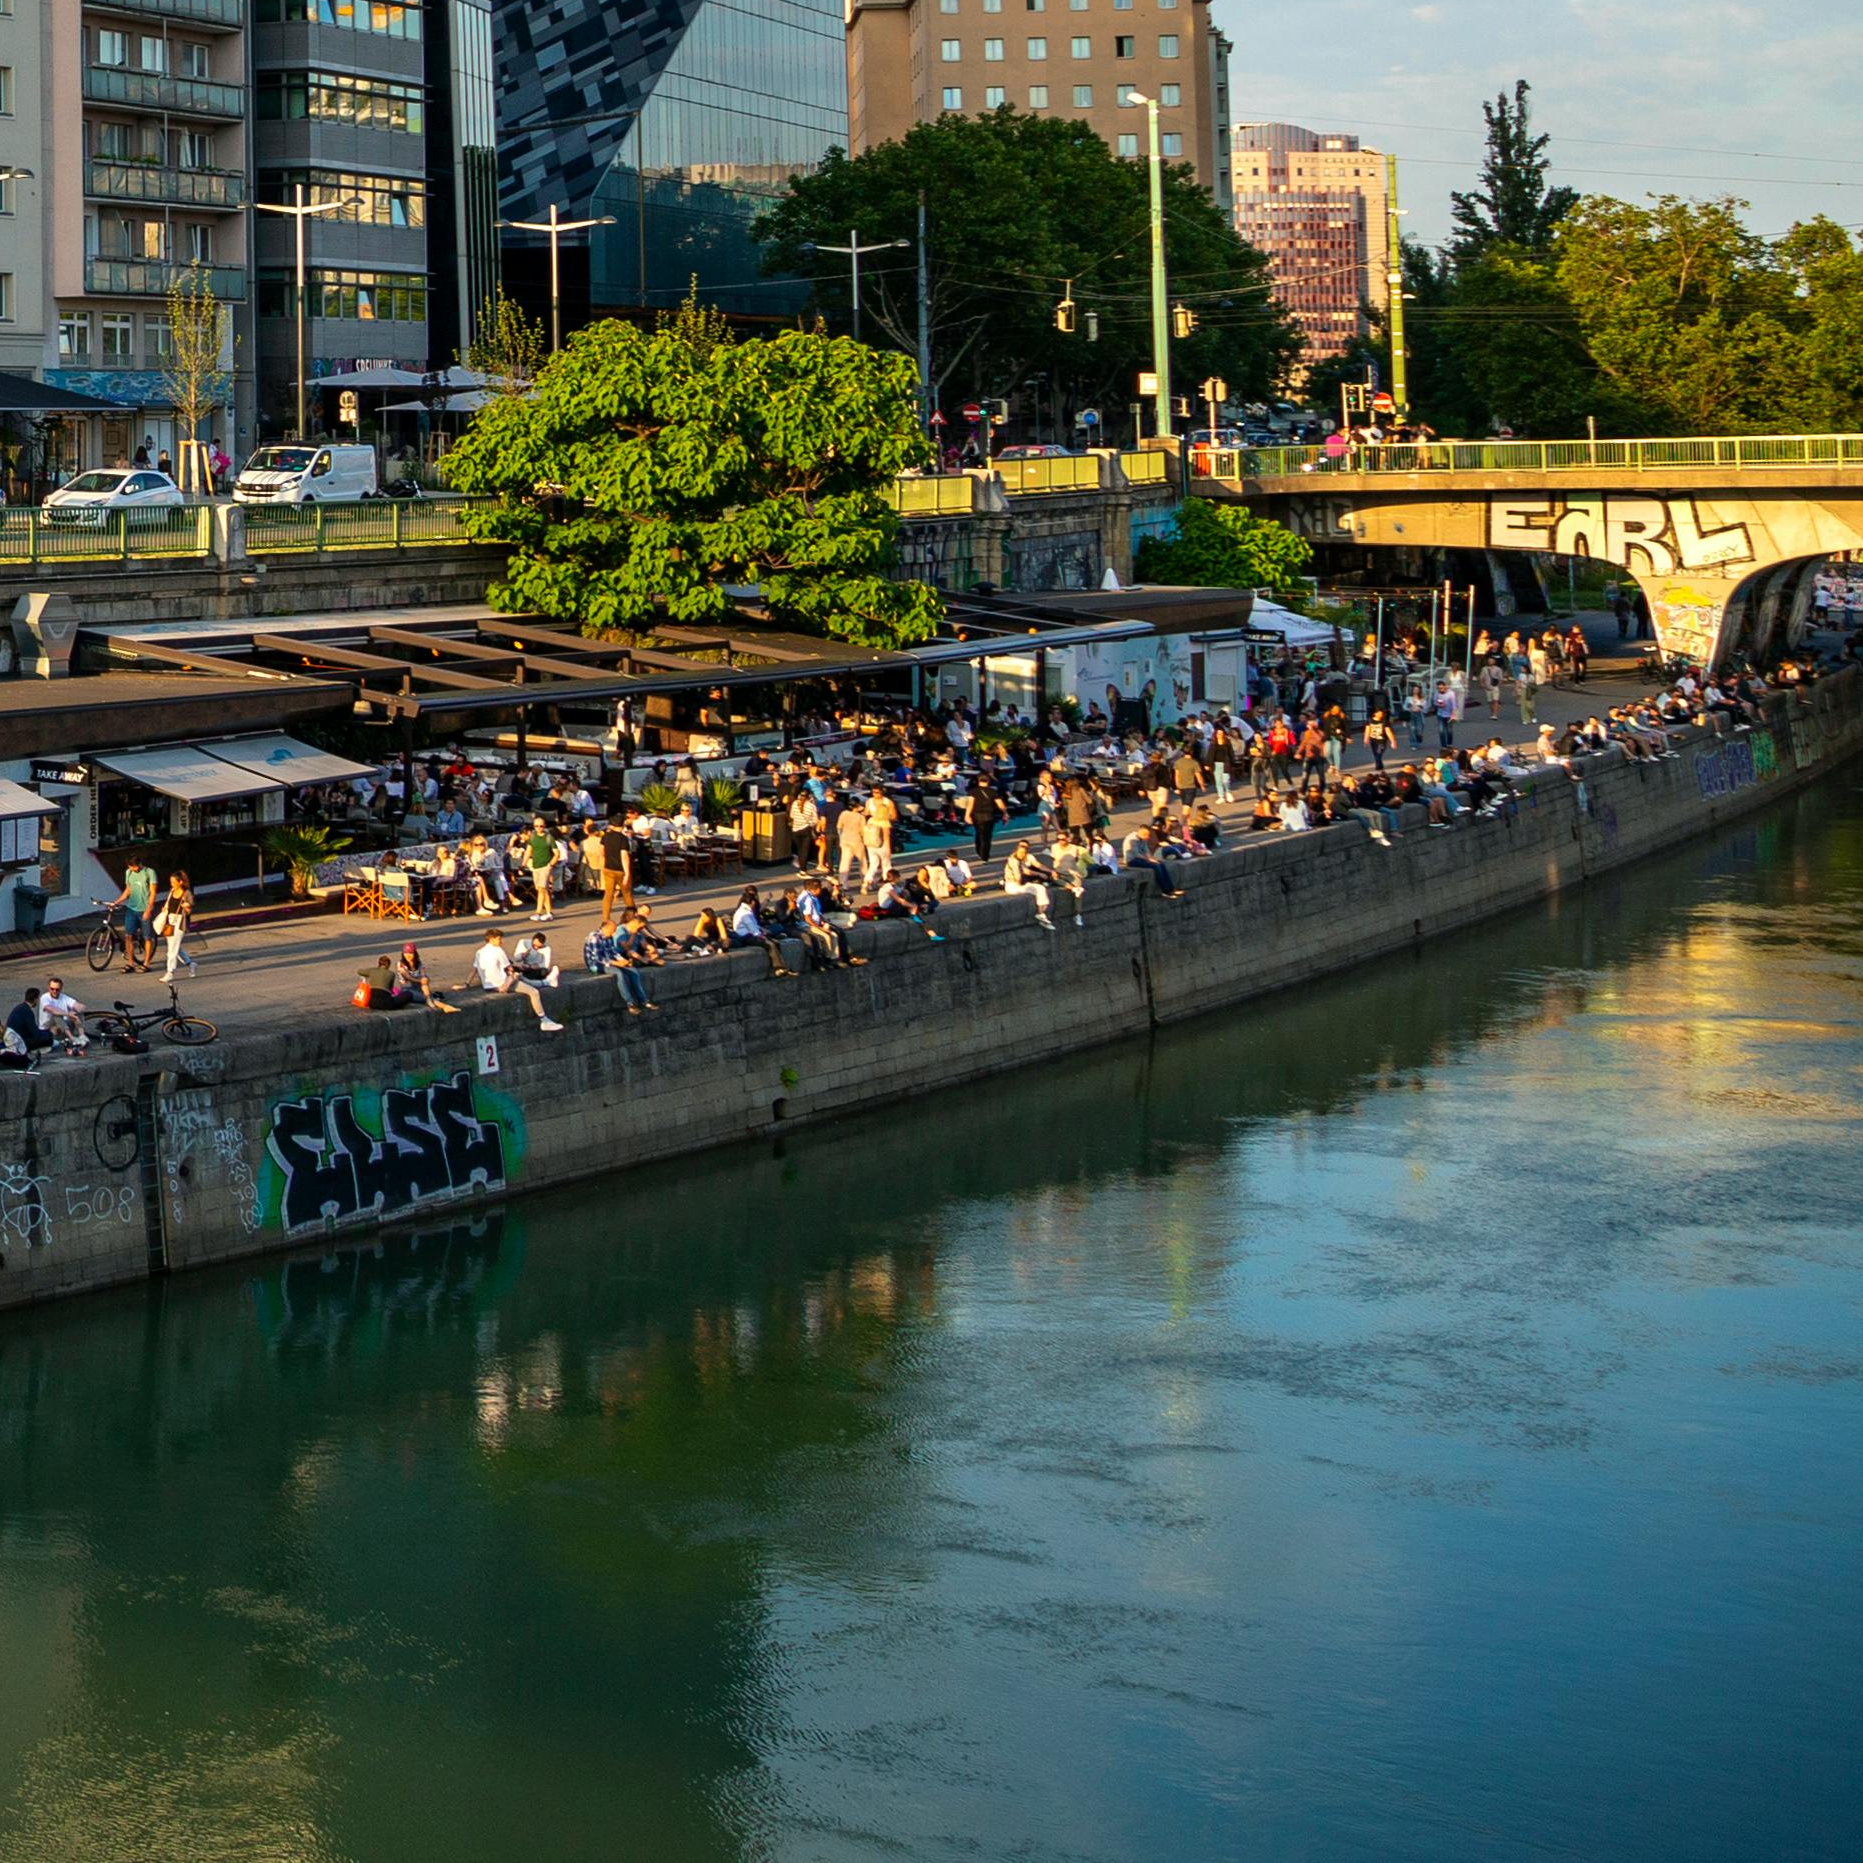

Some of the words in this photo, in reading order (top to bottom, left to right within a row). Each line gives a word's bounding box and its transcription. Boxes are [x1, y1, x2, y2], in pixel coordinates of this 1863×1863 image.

[37, 768, 57, 780] TAKE
[59, 771, 84, 783] AWAY
[485, 1044, 495, 1068] 2
[65, 1185, 136, 1223] 508
